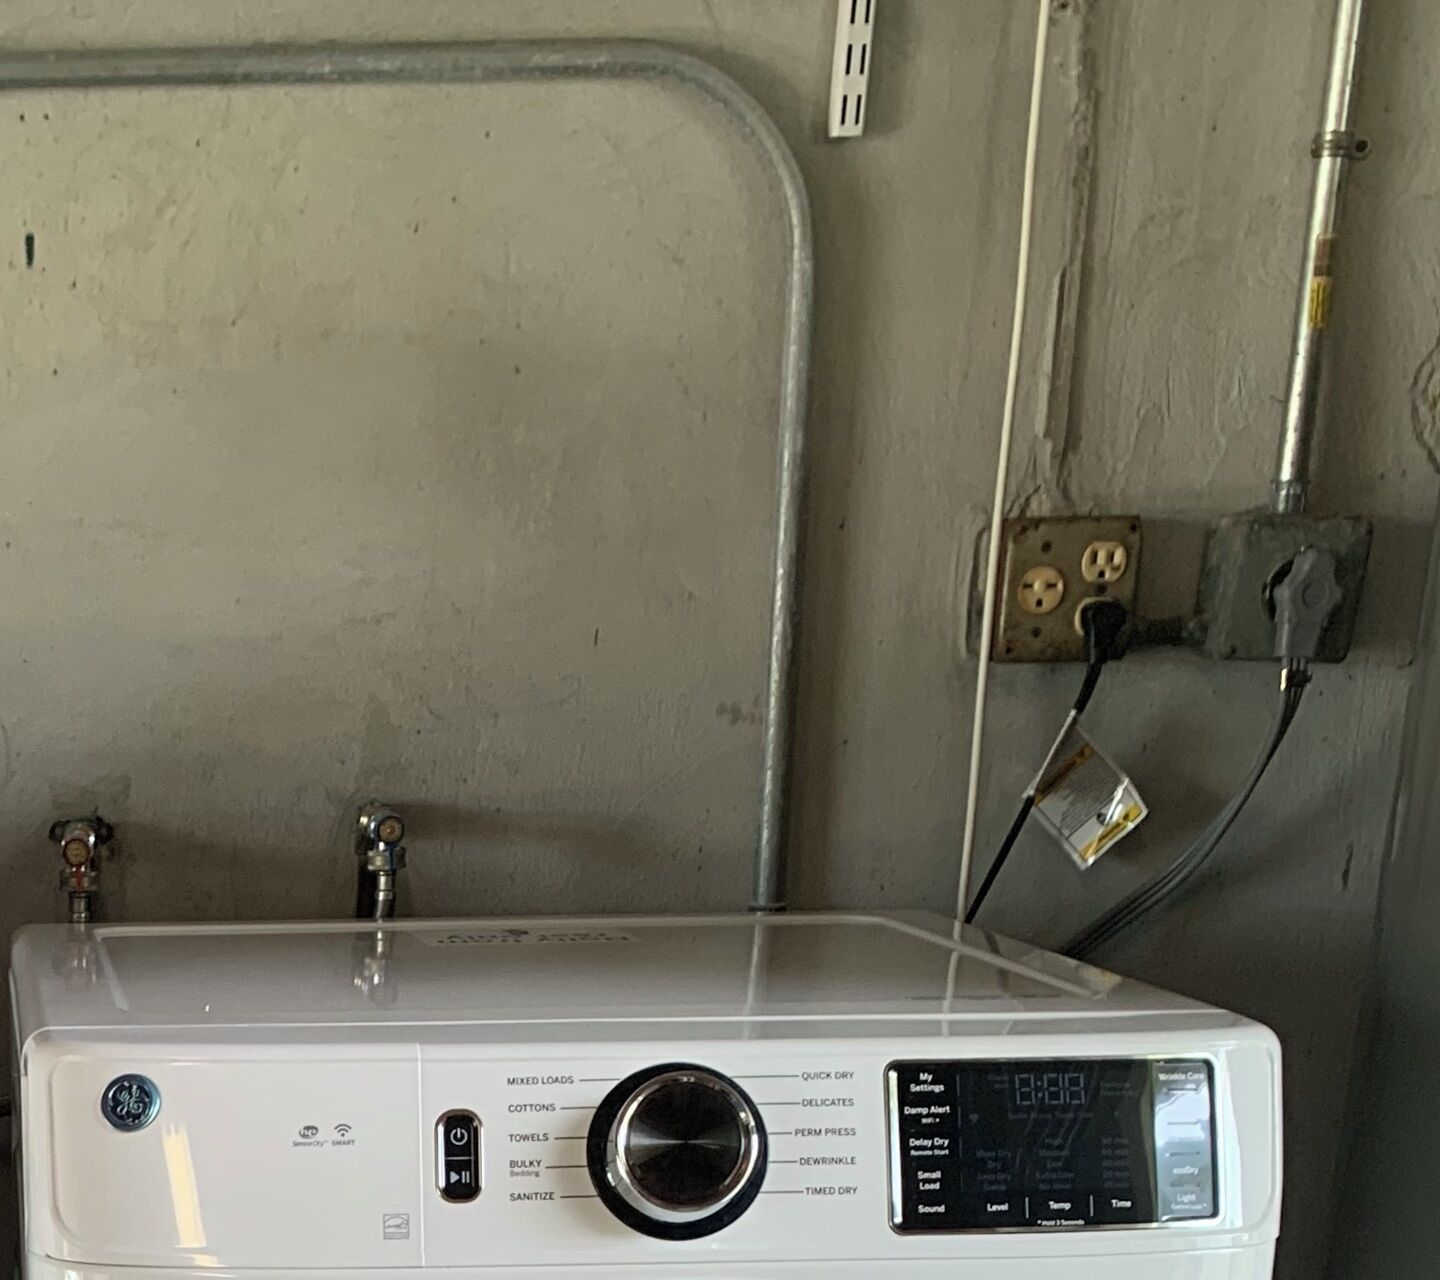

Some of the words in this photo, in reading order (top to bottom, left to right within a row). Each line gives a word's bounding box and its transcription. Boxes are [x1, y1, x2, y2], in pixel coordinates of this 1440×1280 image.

[507, 1076, 539, 1086] MIXED
[541, 1076, 574, 1085] LOADS
[801, 1071, 832, 1081] QUICK
[834, 1071, 855, 1080] DRY
[919, 1072, 933, 1082] My
[909, 1083, 945, 1093] Settings
[801, 1098, 855, 1107] DELICATES
[508, 1103, 556, 1113] COTTONS
[904, 1105, 929, 1116] Damp
[930, 1104, 951, 1114] Alert
[794, 1128, 822, 1137] PERM
[824, 1127, 857, 1136] PRESS
[508, 1133, 549, 1142] TOWELS
[909, 1137, 933, 1148] Delay
[934, 1137, 949, 1147] Dry
[509, 1160, 542, 1168] BULKY
[799, 1156, 857, 1166] DEWRINKLE
[509, 1170, 540, 1178] Bedding
[917, 1170, 942, 1180] Small
[805, 1187, 835, 1195] TIMED
[838, 1187, 858, 1195] DRY
[919, 1181, 941, 1191] Load
[509, 1192, 555, 1201] SANITIZE
[1176, 1193, 1197, 1204] Light
[986, 1202, 1009, 1213] Level
[1048, 1201, 1072, 1211] Temp
[1111, 1198, 1132, 1208] Time
[917, 1204, 946, 1214] Sound
